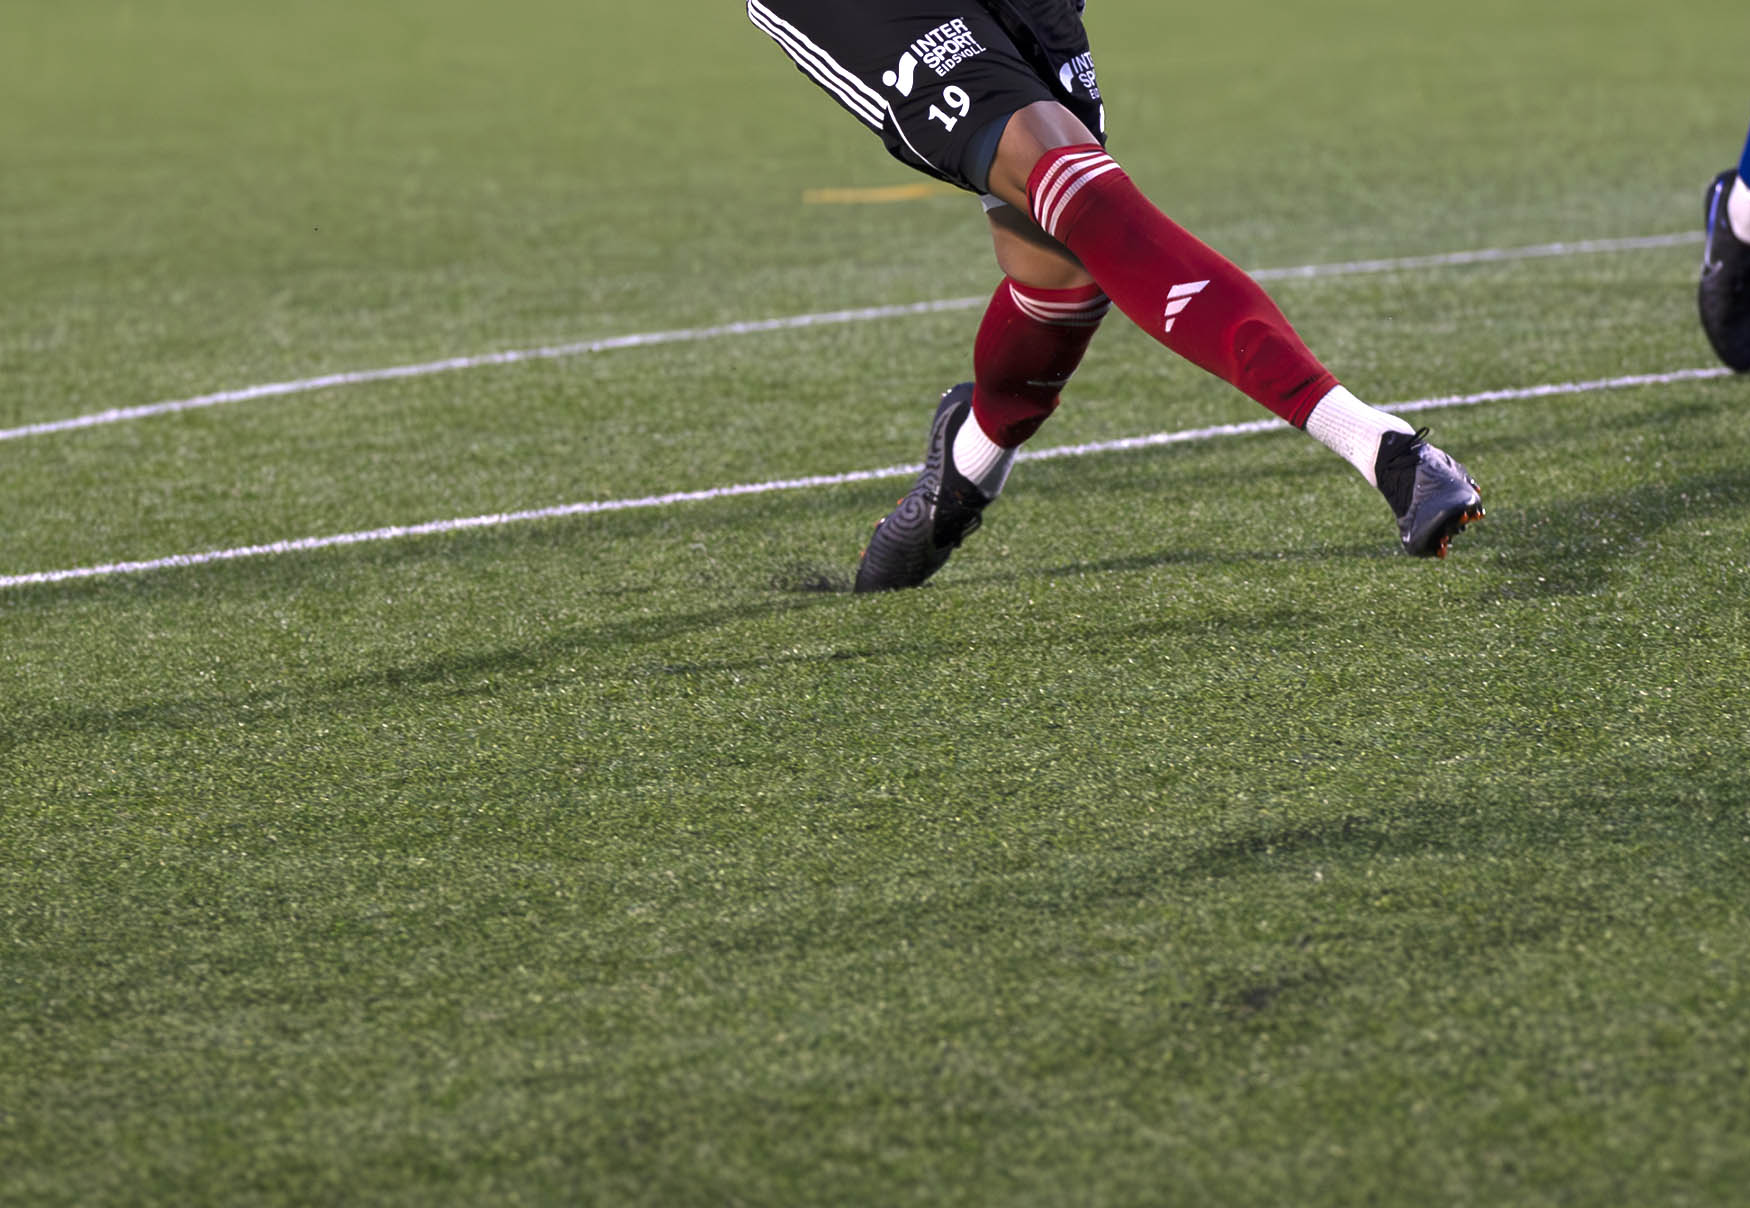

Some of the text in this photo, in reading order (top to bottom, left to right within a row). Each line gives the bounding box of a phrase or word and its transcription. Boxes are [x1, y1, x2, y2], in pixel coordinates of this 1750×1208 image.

[910, 18, 968, 58] INTER
[923, 31, 977, 69] SPORT
[935, 43, 987, 77] EIDSVOLL
[928, 85, 970, 133] 19
